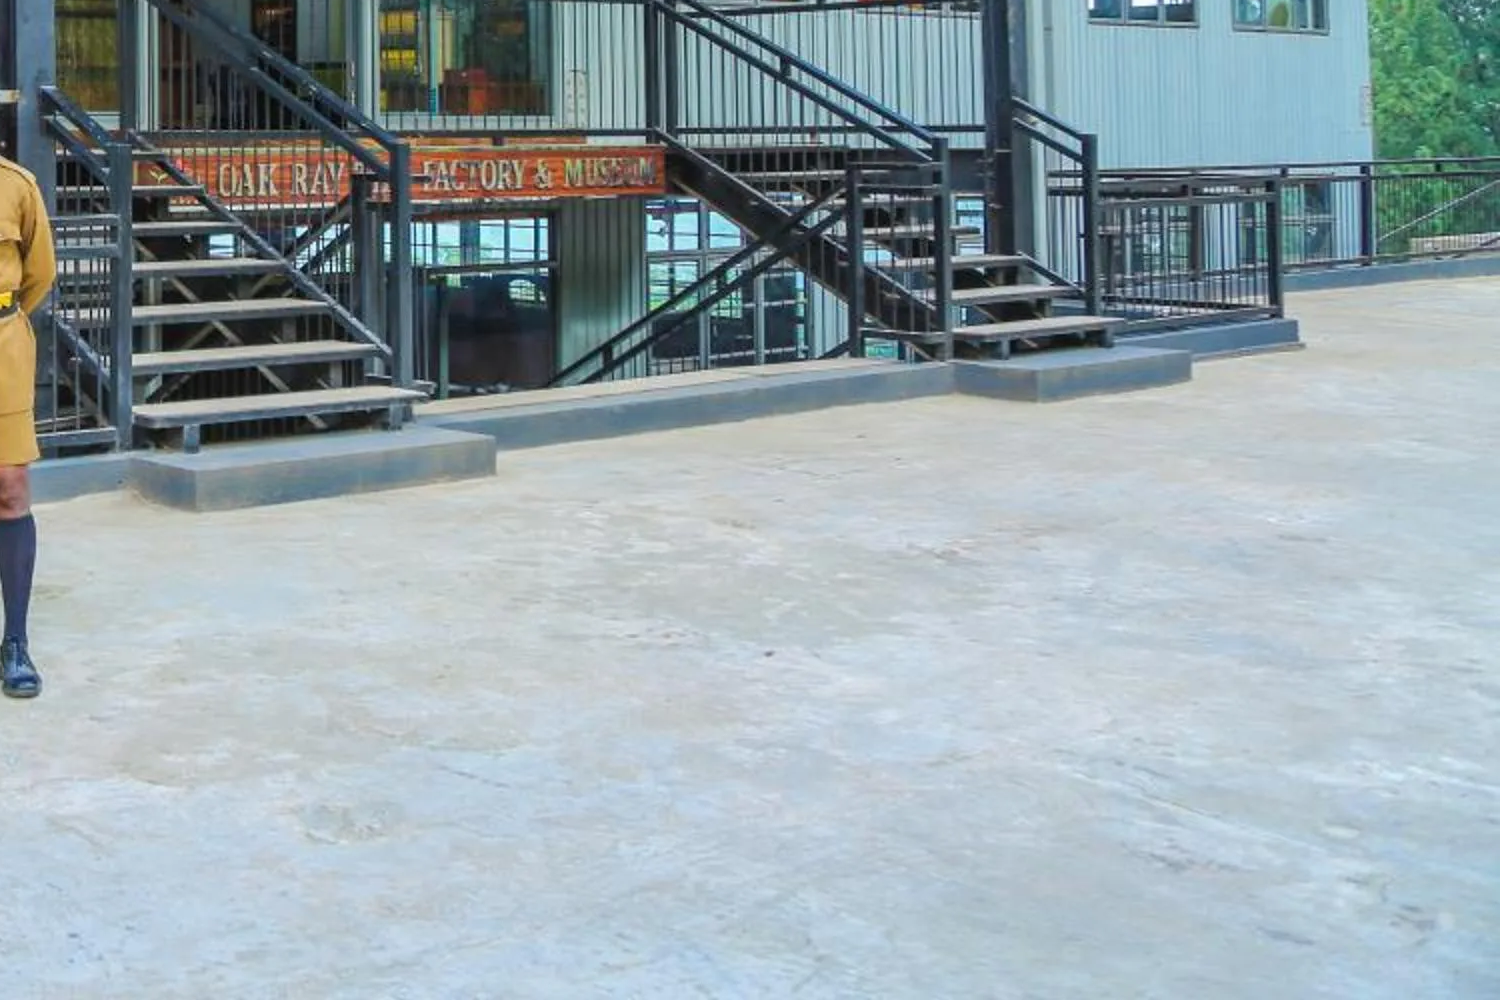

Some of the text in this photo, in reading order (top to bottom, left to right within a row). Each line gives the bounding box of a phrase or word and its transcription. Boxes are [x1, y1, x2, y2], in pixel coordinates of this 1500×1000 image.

[219, 163, 281, 198] OAK
[291, 163, 345, 197] RAY
[423, 158, 527, 192] FACTORY
[532, 159, 553, 190] &
